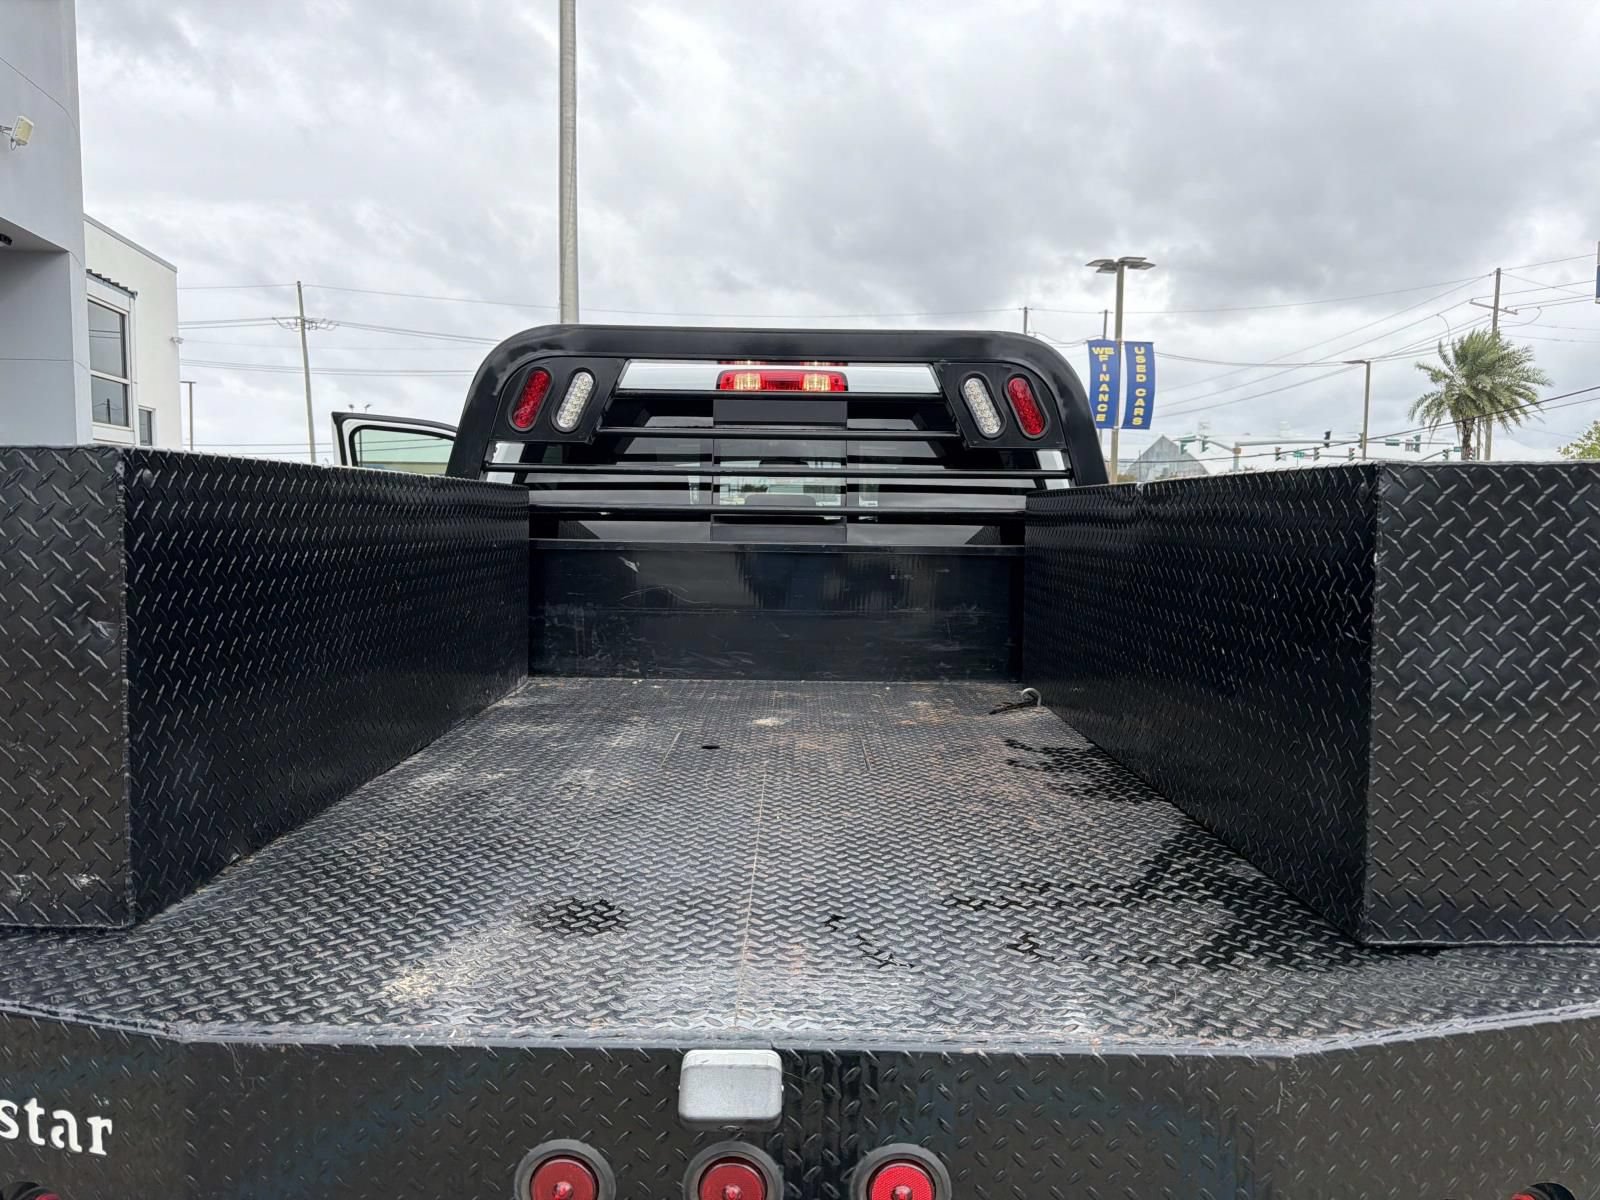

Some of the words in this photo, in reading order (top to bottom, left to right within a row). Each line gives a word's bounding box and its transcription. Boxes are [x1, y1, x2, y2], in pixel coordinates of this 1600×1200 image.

[1091, 347, 1115, 355] WE
[1134, 346, 1147, 382] USED
[1096, 355, 1110, 421] FINANCE
[1132, 388, 1147, 425] CARS
[0, 1097, 113, 1156] star
